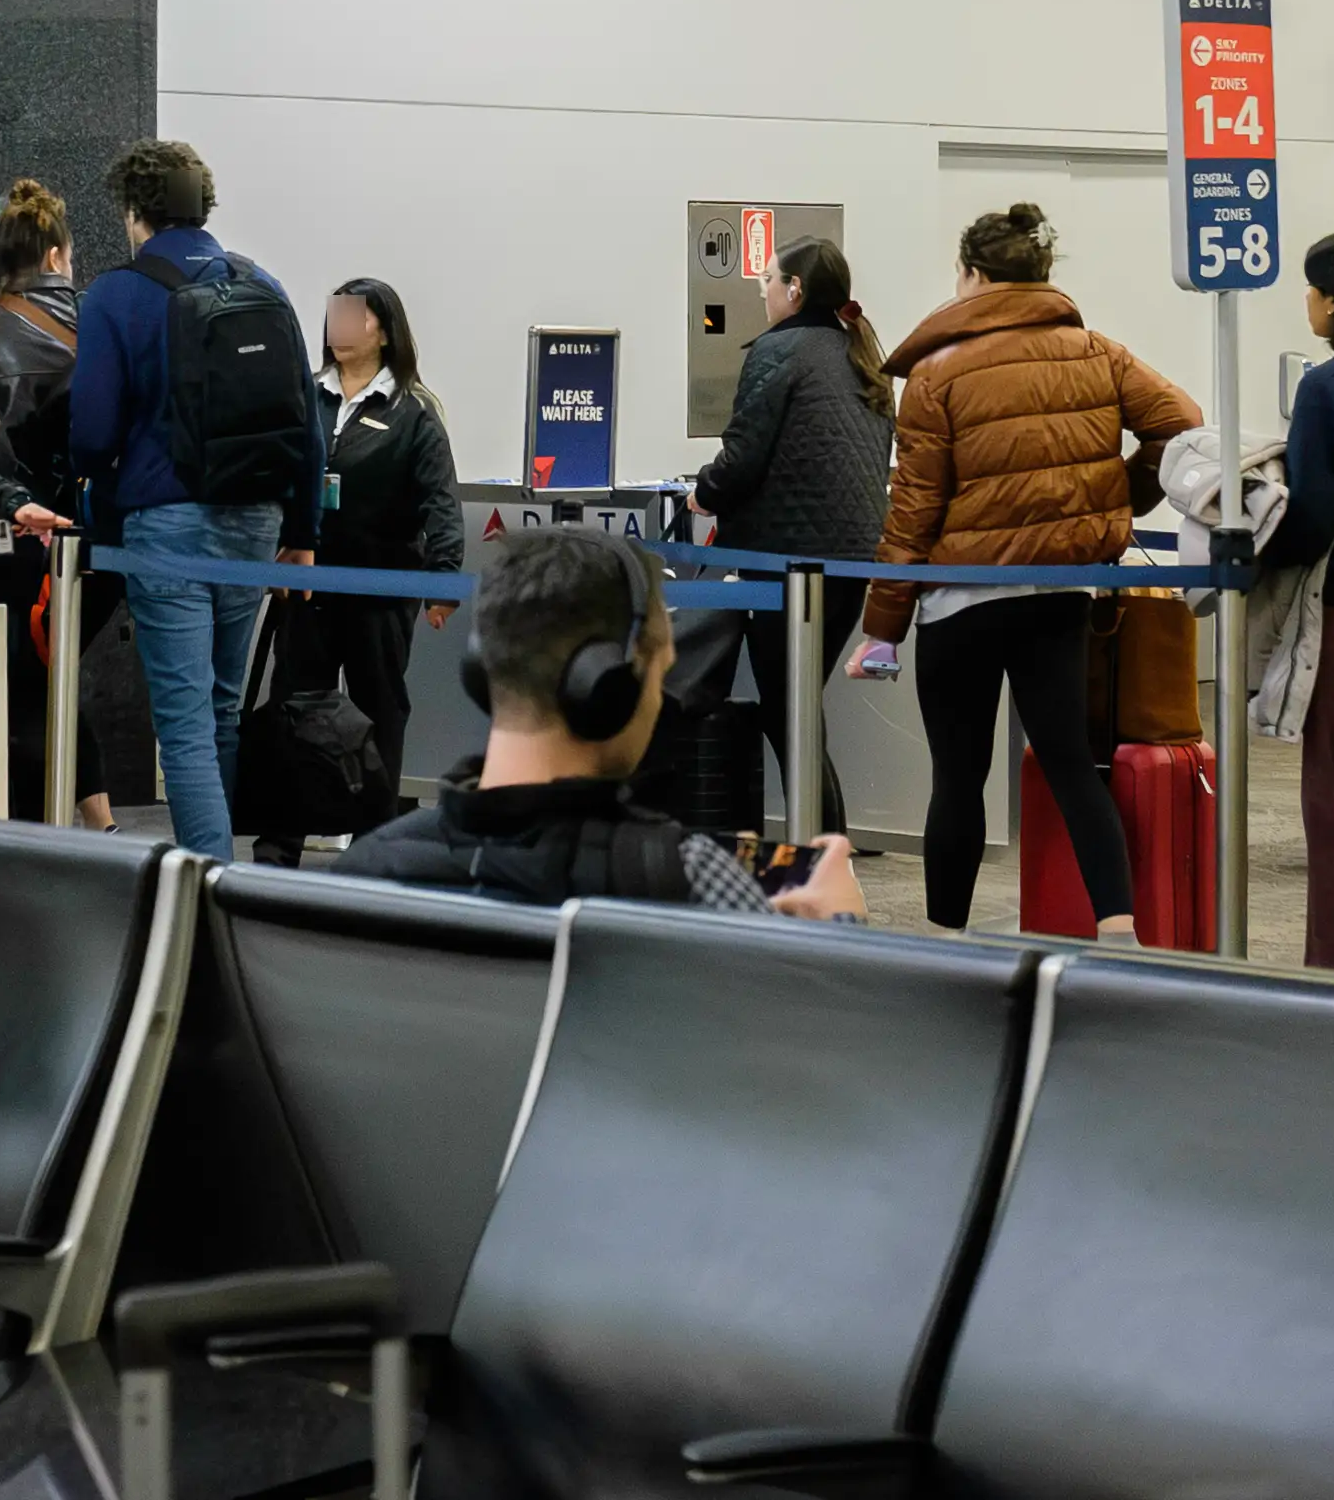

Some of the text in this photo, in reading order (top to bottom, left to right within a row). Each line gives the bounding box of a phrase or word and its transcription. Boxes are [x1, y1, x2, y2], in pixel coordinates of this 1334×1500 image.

[1215, 39, 1238, 50] SKY
[1215, 51, 1265, 63] PRIORITY
[1210, 76, 1248, 91] ZONES
[1195, 94, 1264, 145] 1-4
[1192, 173, 1233, 185] GENERAL
[1193, 186, 1241, 198] BOARDING
[1213, 207, 1252, 221] ZONES
[1199, 223, 1271, 278] 5-8
[559, 343, 592, 355] DELTA
[553, 389, 594, 405] PLEASE
[541, 405, 604, 422] WAIT HERE
[523, 510, 644, 541] DTA
